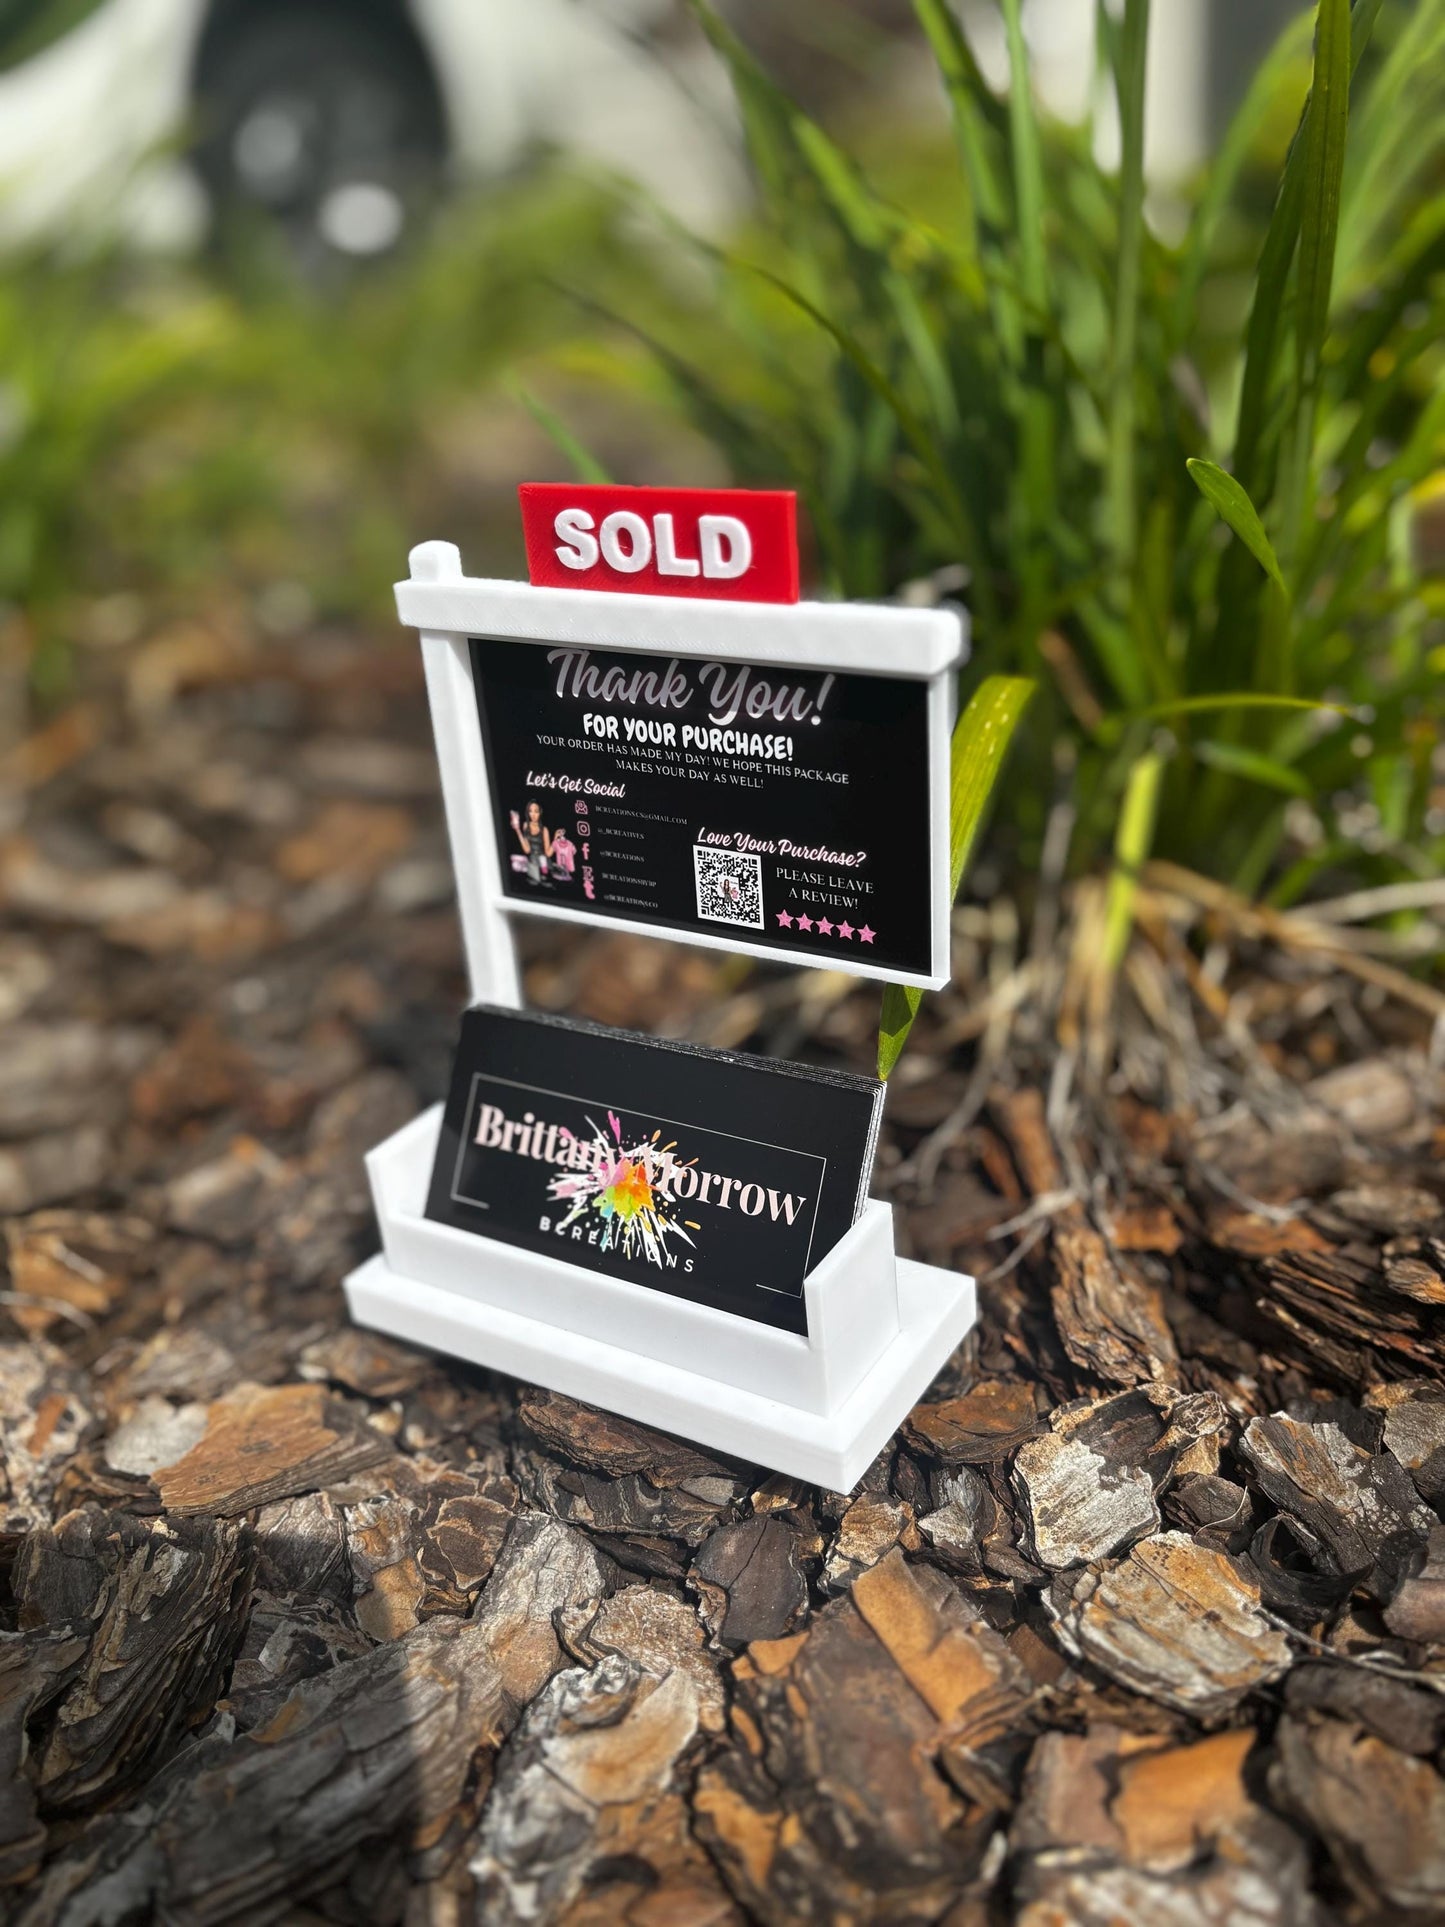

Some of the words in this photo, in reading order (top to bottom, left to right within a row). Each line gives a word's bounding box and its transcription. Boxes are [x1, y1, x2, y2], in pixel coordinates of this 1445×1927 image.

[554, 508, 751, 579] SOLD
[547, 648, 694, 708] Thank
[699, 661, 836, 726] You!
[583, 713, 619, 740] FOR
[623, 717, 677, 747] YOUR
[682, 724, 793, 761] PURCHASE!
[536, 734, 566, 747] YOUR
[567, 739, 604, 752] ORDER
[607, 743, 628, 755] HAS
[630, 746, 662, 759] MADE
[665, 751, 682, 762] MY
[685, 753, 710, 766] DAY!
[713, 757, 730, 768] WE
[732, 759, 763, 773] HOPE
[764, 763, 791, 776] THIS
[794, 767, 849, 784] PACKAGE
[616, 759, 653, 773] MAKES
[655, 764, 686, 778] YOUR
[688, 769, 710, 781] DAY
[713, 773, 727, 783] AS
[730, 774, 764, 788] WELL!
[526, 771, 557, 789] Let's
[558, 775, 583, 793] Get
[583, 778, 625, 798] Social
[697, 826, 732, 846] Love
[733, 832, 777, 852] Your
[778, 839, 867, 867] Purchase?
[776, 867, 826, 886] PLEASE
[829, 876, 874, 894] LEAVE
[788, 887, 798, 899] A
[801, 889, 859, 909] REVIEW!
